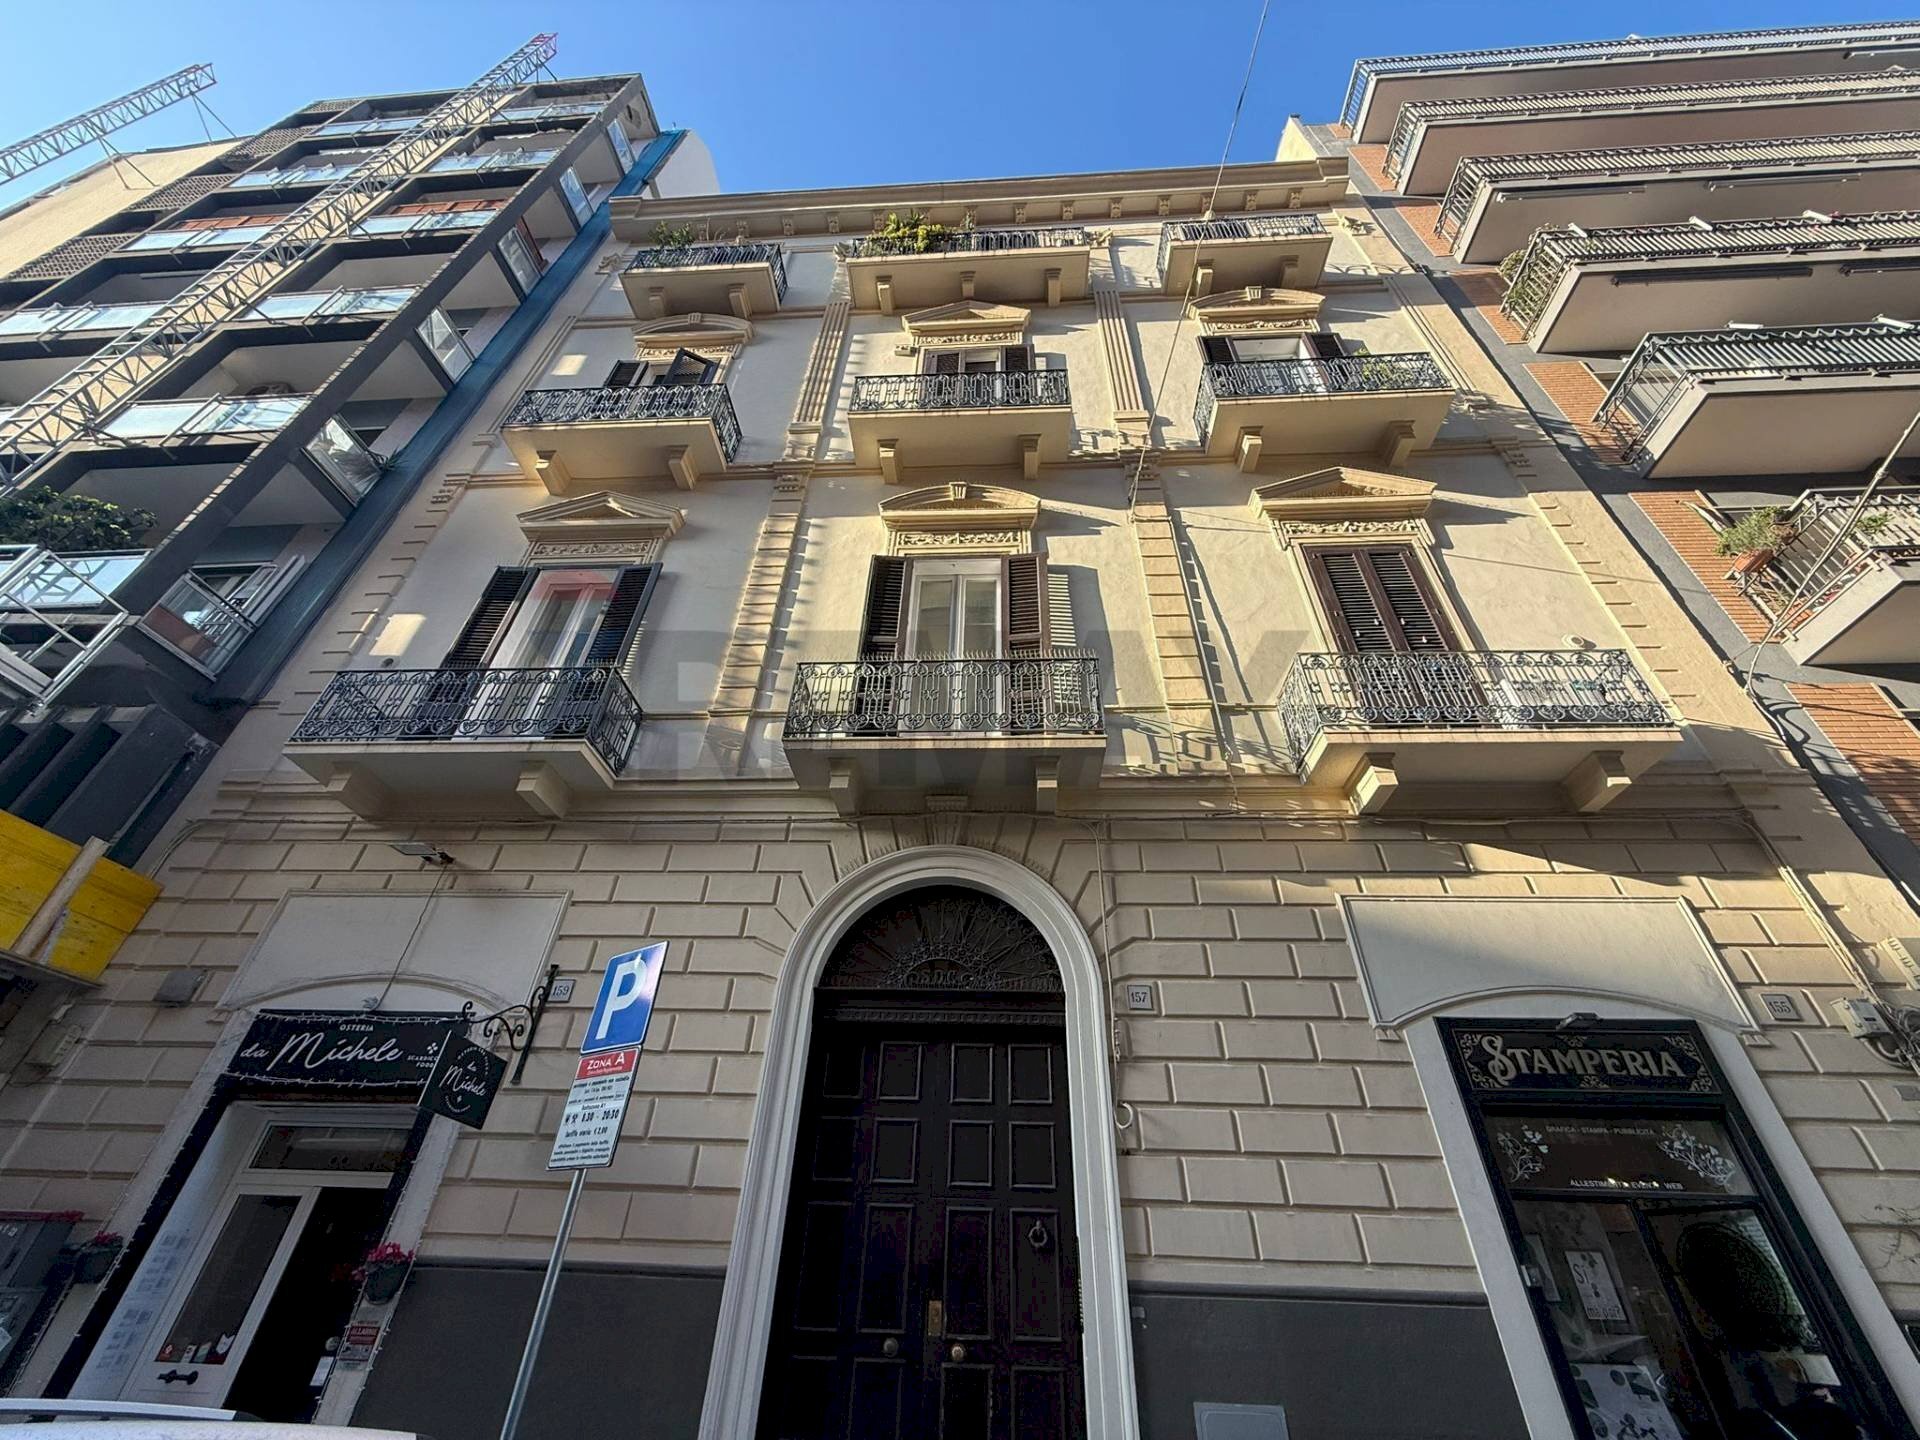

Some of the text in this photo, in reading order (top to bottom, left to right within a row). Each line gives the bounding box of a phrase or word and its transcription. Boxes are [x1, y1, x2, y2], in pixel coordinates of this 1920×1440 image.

[553, 985, 570, 995] 159
[595, 957, 648, 1040] P
[1131, 991, 1148, 1003] 157
[1768, 1001, 1791, 1014] 155
[339, 1024, 374, 1032] OSTERIA
[239, 1032, 404, 1072] da Michele
[586, 1059, 612, 1070] ZONA
[615, 1052, 625, 1065] A
[1480, 1034, 1686, 1086] STAMPERIA
[438, 1064, 487, 1097] Michele
